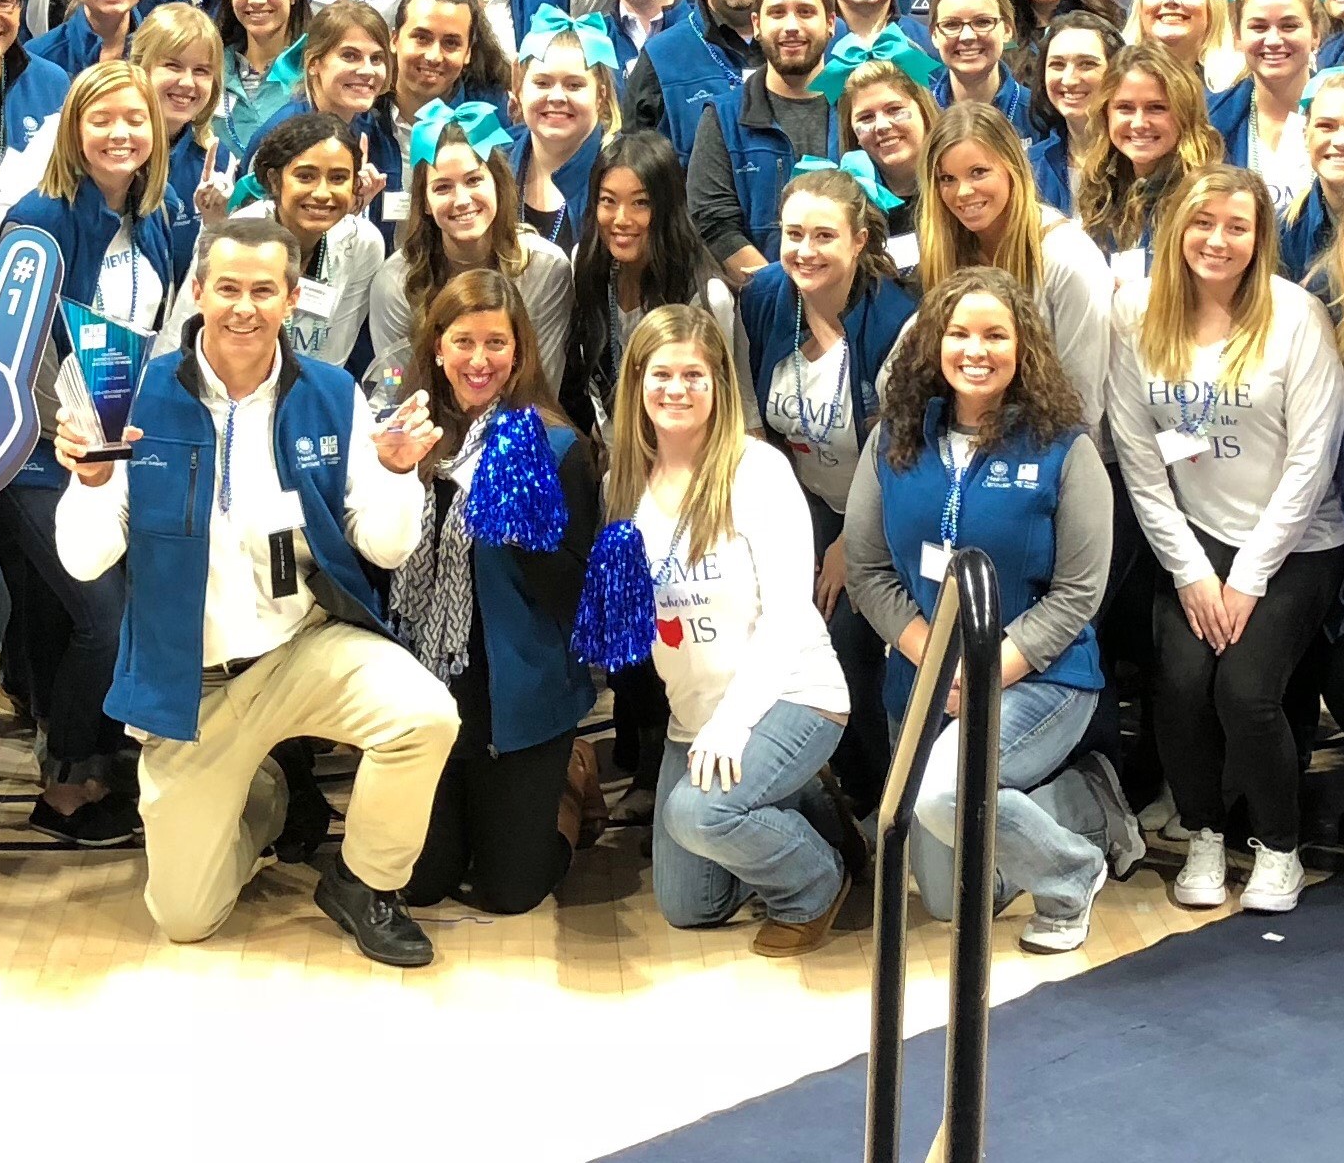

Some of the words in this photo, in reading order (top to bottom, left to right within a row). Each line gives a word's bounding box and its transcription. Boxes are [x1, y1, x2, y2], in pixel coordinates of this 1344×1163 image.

[12, 256, 36, 285] #
[7, 288, 22, 316] 1
[1147, 379, 1253, 408] HOME
[1210, 435, 1241, 459] IS
[649, 552, 722, 587] OME
[659, 595, 690, 609] where
[691, 592, 711, 606] the
[687, 616, 717, 644] IS
